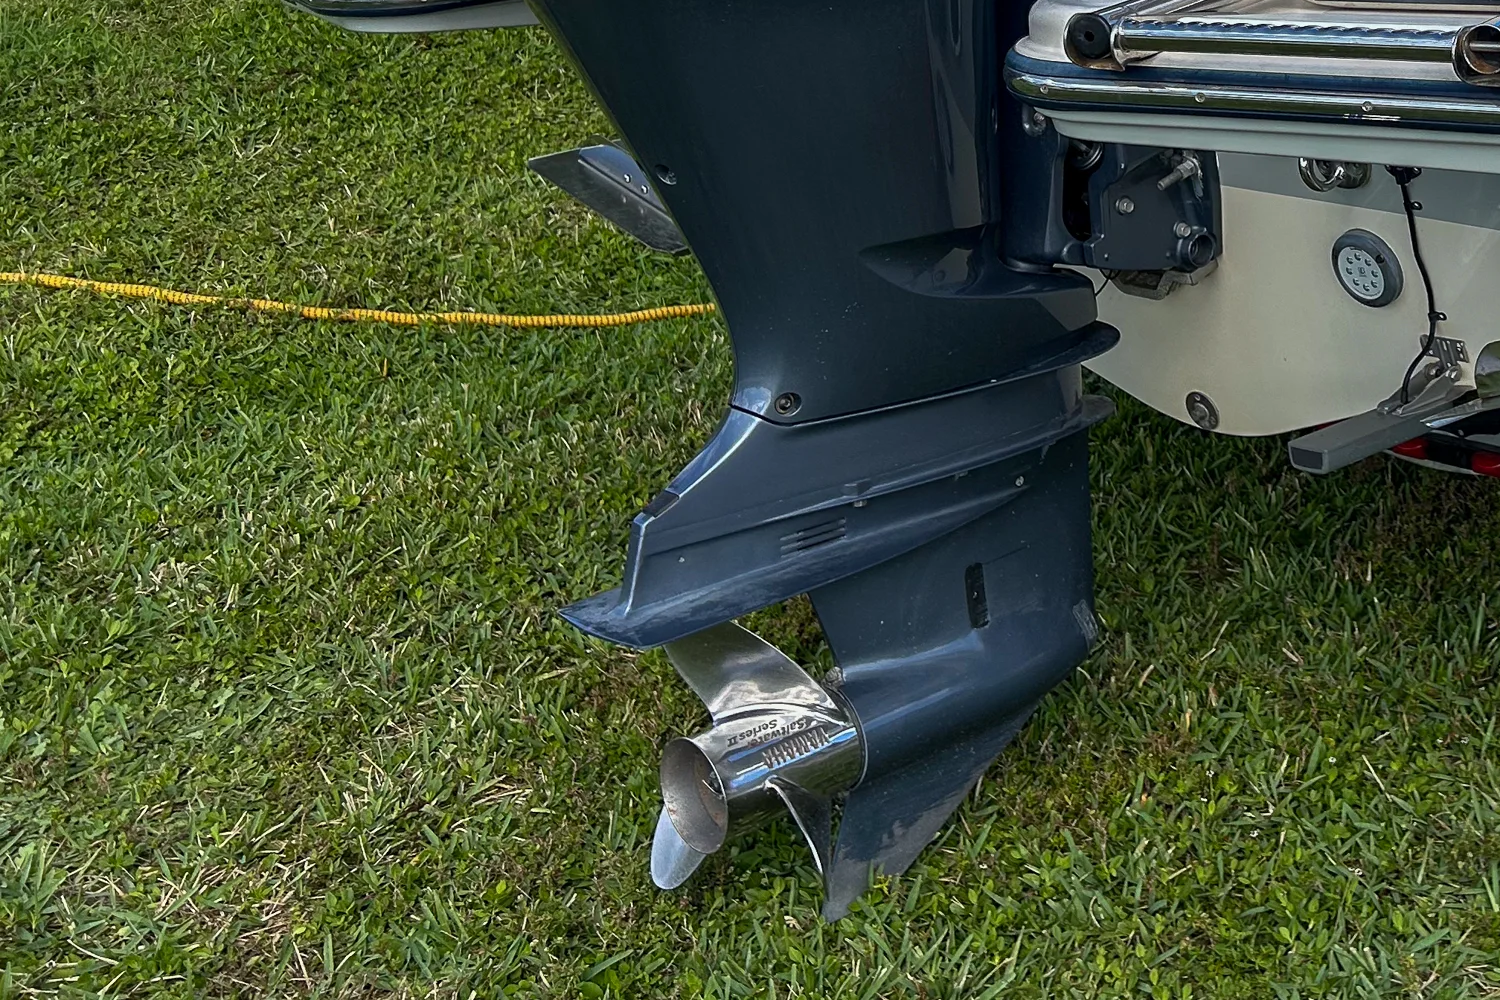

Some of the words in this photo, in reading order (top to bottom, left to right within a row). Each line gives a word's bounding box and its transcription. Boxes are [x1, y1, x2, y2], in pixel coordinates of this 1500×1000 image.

[738, 719, 778, 740] Series
[746, 718, 807, 748] Saltwater
[762, 727, 830, 769] YAMAHA
